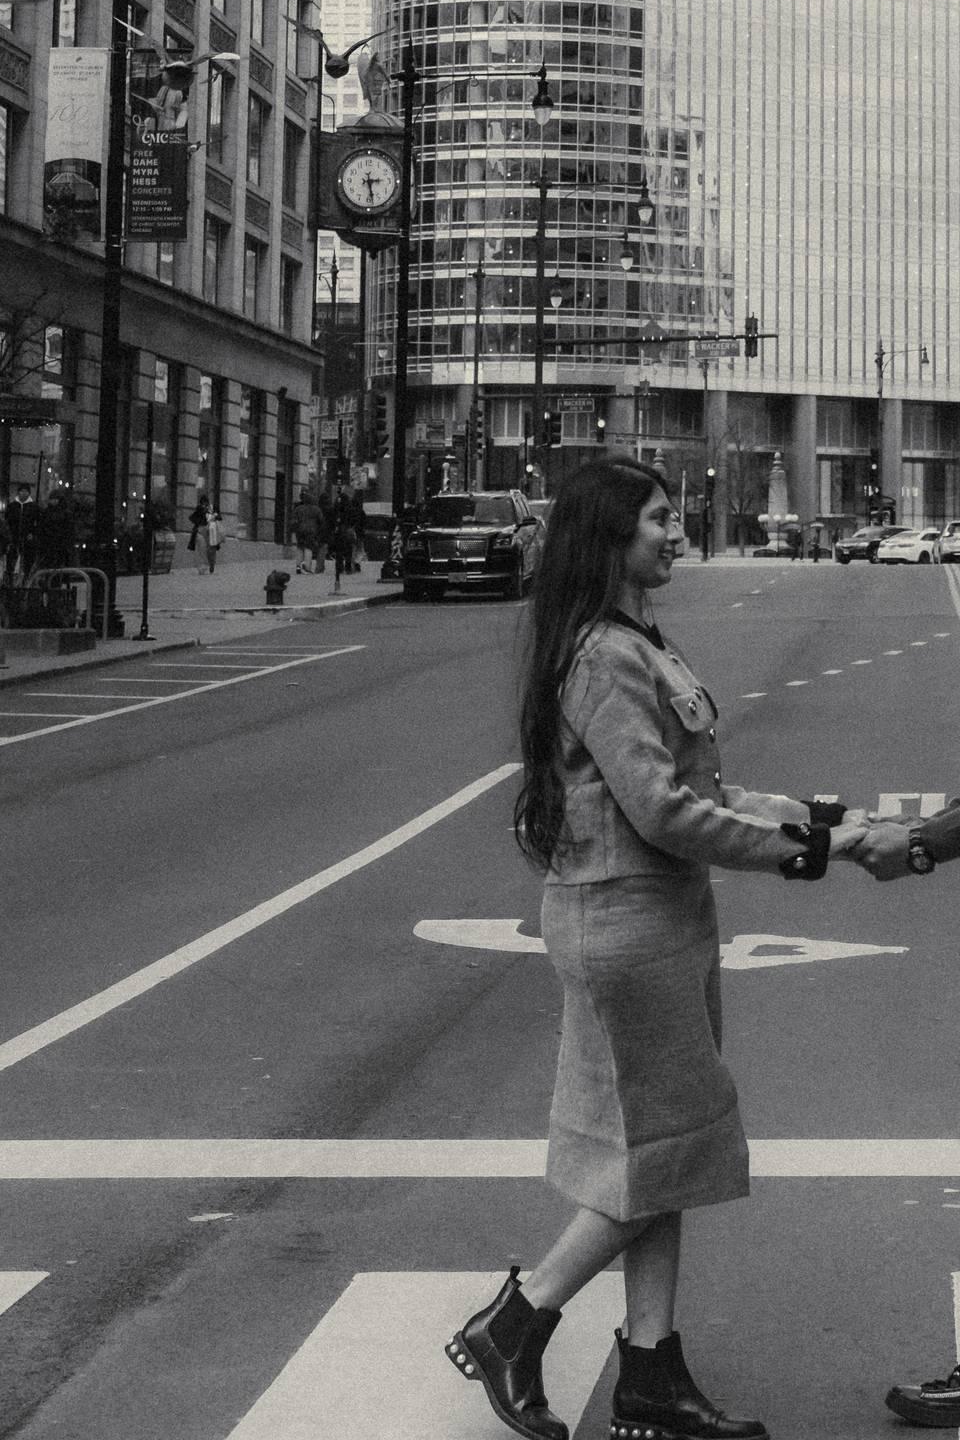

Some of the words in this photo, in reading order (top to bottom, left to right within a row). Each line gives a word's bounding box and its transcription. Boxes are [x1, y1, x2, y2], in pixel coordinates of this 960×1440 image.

[141, 132, 169, 147] CMC
[132, 158, 159, 166] DAME
[132, 168, 160, 176] MYRA
[131, 177, 157, 186] HESS
[131, 187, 172, 195] CONCERTS
